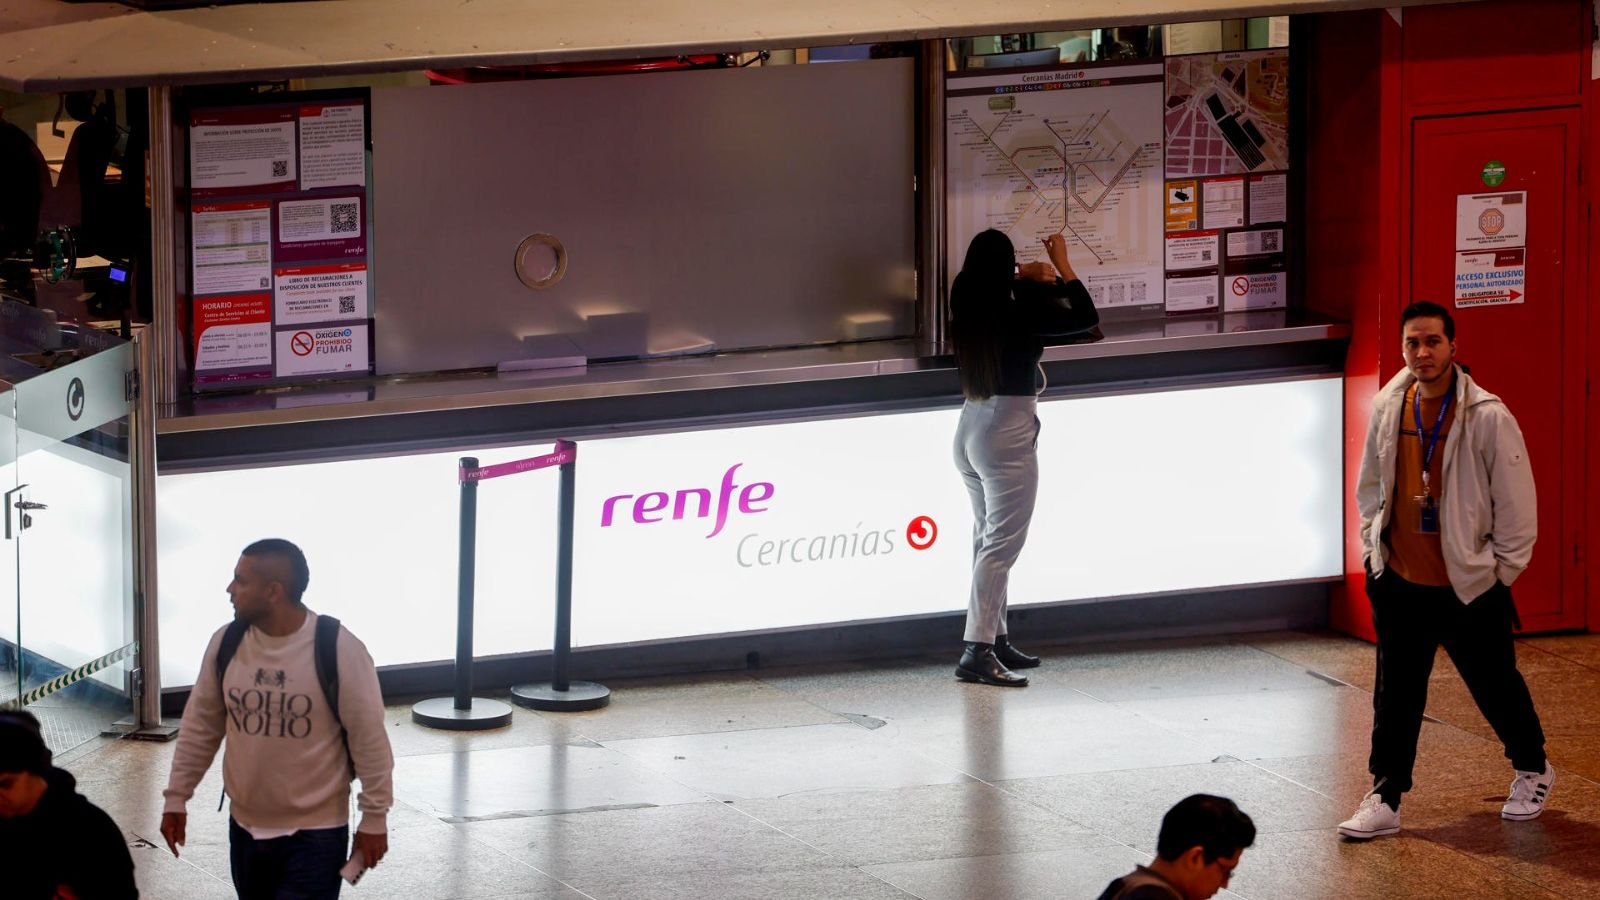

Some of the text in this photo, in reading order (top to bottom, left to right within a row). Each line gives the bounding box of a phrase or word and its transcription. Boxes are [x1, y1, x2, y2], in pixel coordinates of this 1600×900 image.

[1055, 72, 1077, 80] Madrid
[1482, 215, 1502, 228] STOP
[344, 245, 364, 255] renfe
[1456, 269, 1524, 281] ACCESO EXCLUSIVO
[1487, 279, 1524, 287] AUTORIZADO
[1250, 287, 1277, 295] FUMAR
[202, 301, 232, 310] HORARIO
[316, 338, 352, 346] PROHIBIDO
[316, 345, 352, 355] FUMAR
[546, 453, 566, 464] renfe
[467, 468, 489, 478] renfe
[601, 464, 775, 539] renfe
[736, 522, 896, 568] Cercanías
[228, 687, 312, 719] SOHO
[228, 704, 312, 739] NOHO
